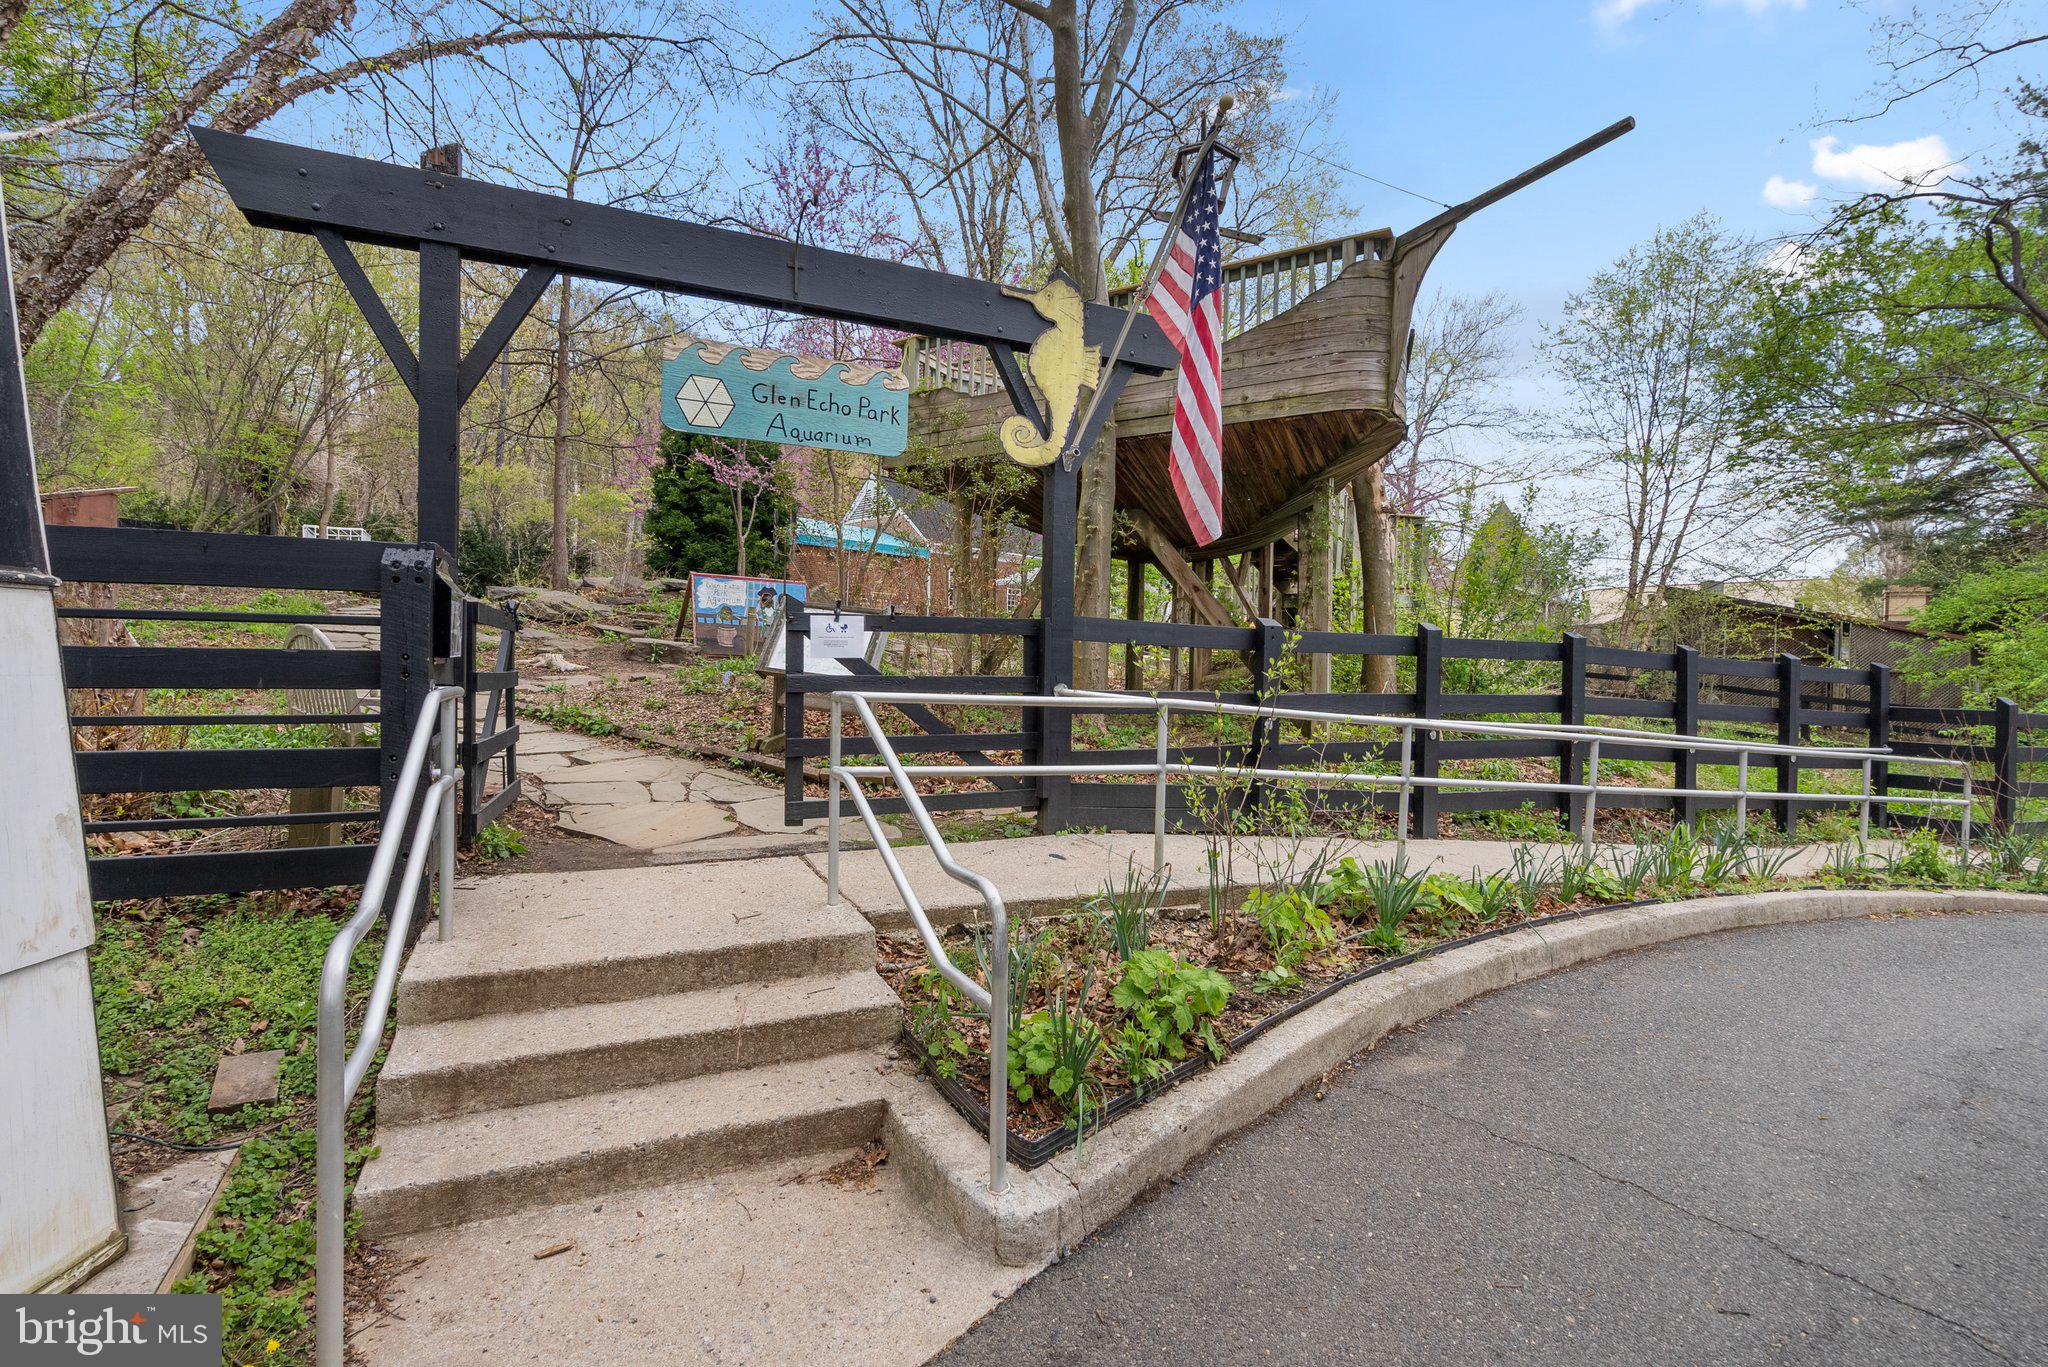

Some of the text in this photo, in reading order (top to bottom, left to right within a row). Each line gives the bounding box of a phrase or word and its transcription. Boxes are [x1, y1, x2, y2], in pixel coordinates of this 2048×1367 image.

[751, 383, 901, 426] Glen Echo Park
[765, 413, 872, 447] Aquarium
